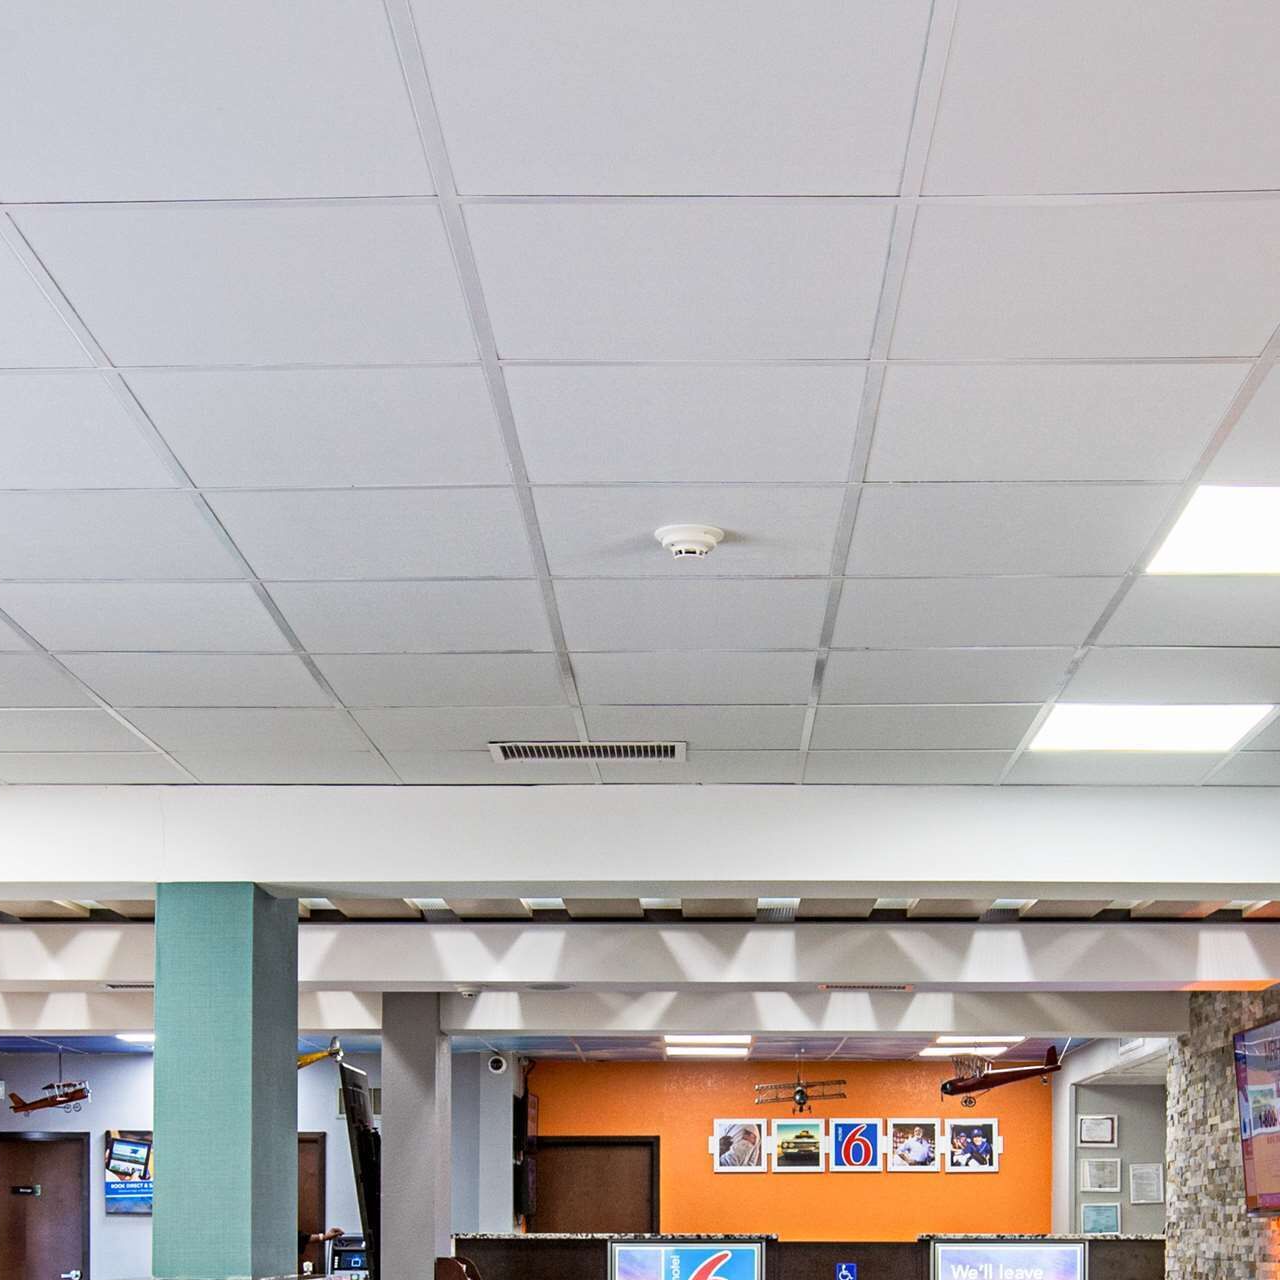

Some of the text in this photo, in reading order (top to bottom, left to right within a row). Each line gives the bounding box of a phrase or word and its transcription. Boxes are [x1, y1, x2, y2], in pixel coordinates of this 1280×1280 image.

[841, 1123, 873, 1167] 6
[951, 1263, 1044, 1280] We'll leave
